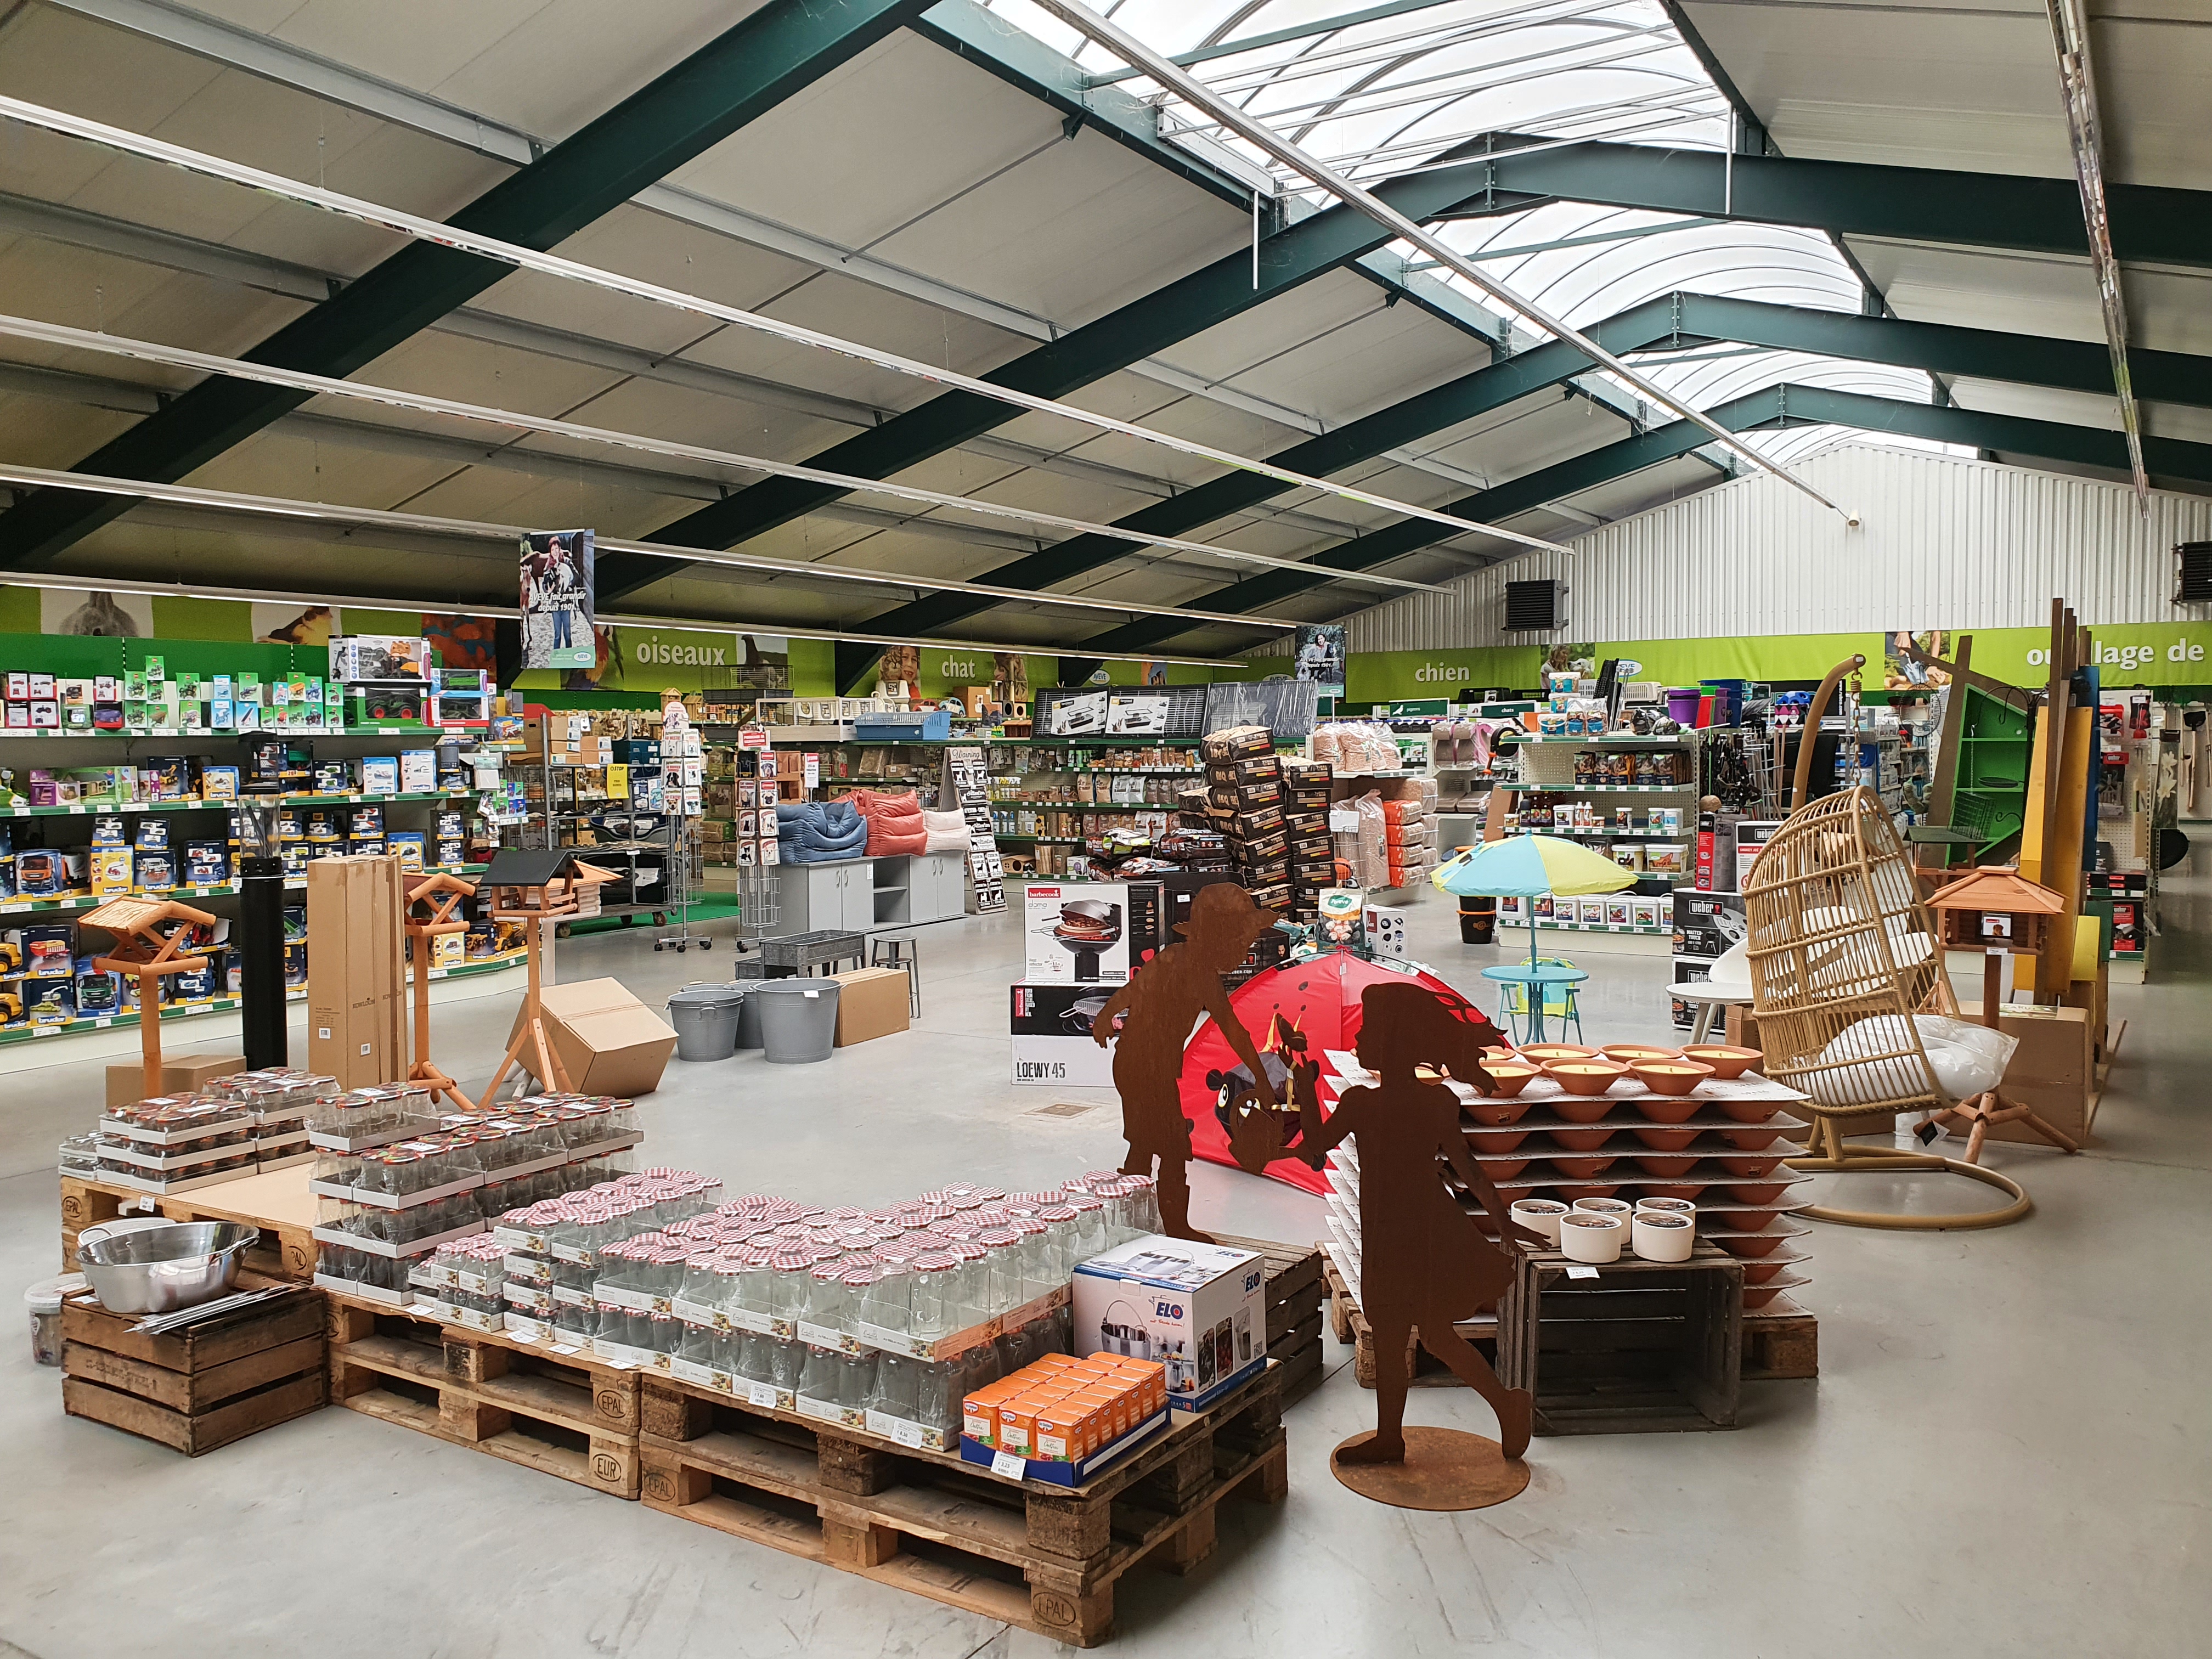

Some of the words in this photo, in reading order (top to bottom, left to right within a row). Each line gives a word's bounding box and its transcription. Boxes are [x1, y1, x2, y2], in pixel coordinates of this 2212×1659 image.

[529, 592, 549, 602] AVEVE
[550, 592, 562, 604] fait
[562, 591, 586, 602] grandir
[538, 602, 558, 614] depuis
[636, 635, 725, 666] oiseaux
[2168, 638, 2204, 662] de
[941, 655, 976, 679] chat
[1415, 662, 1470, 681] chien
[952, 749, 980, 760] Warning
[1029, 889, 1061, 898] barbecook
[1691, 901, 1714, 913] weber
[1017, 1062, 1050, 1079] LOEWY
[1051, 1062, 1066, 1079] 45
[1245, 1271, 1261, 1293] ELO
[1155, 1301, 1183, 1320] ELO
[601, 1395, 624, 1417] EPAL
[597, 1457, 617, 1479] EUR
